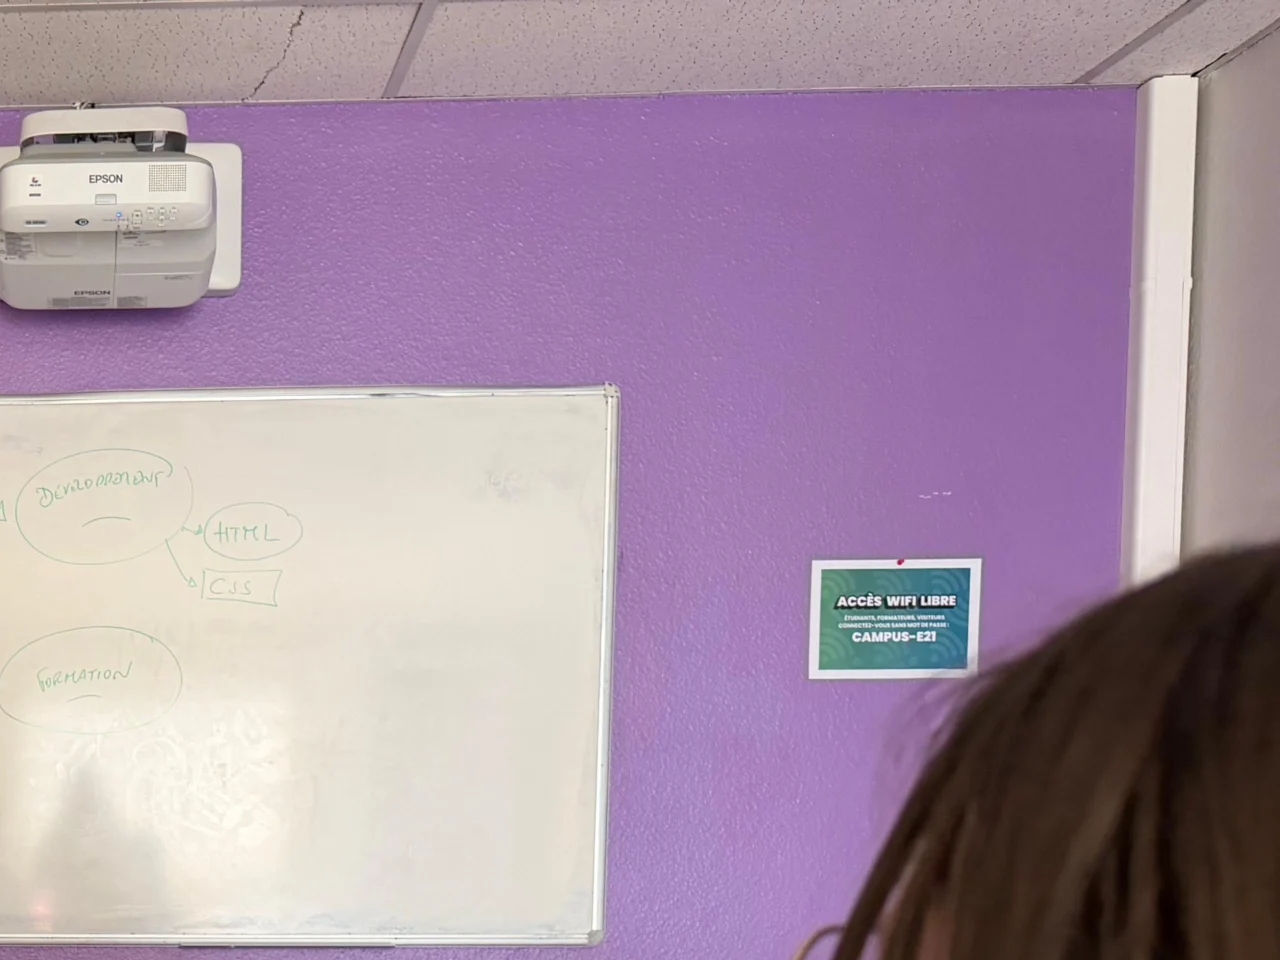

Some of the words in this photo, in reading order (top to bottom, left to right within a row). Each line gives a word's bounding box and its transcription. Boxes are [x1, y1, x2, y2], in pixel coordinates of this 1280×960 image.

[89, 174, 123, 184] EPSON
[213, 521, 281, 543] HTML
[209, 578, 253, 595] CSS
[836, 592, 882, 607] ACCÈS
[886, 595, 917, 607] WIFI
[920, 595, 957, 606] LIBRE
[852, 631, 937, 642] CAMPUS-E21
[36, 660, 133, 692] FORMATION
